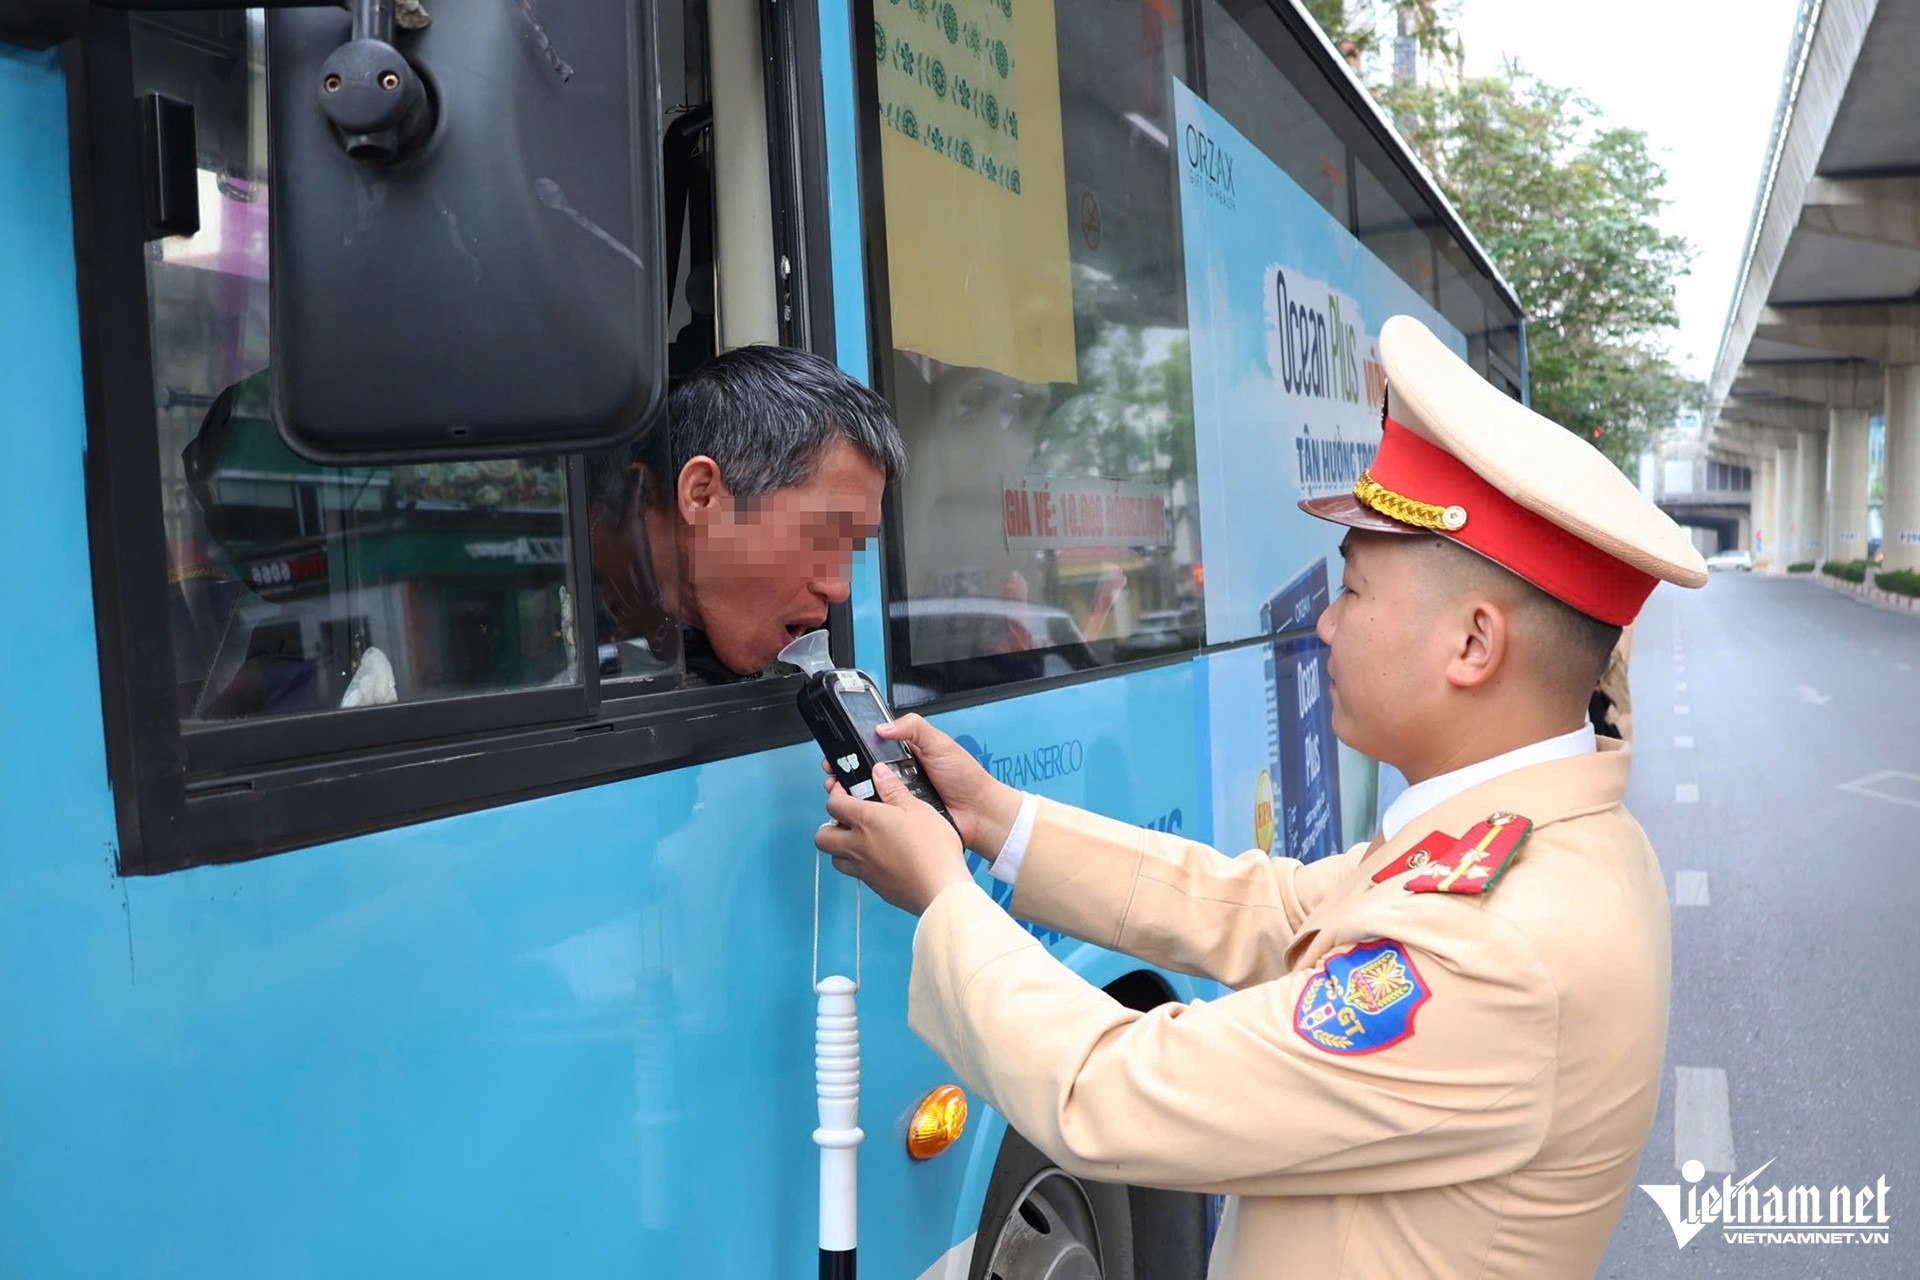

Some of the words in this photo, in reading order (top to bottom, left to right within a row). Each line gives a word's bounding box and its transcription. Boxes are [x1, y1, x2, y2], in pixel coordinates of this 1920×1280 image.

[1186, 123, 1235, 197] ORZAX
[1005, 480, 1032, 537] GIÁ
[1297, 656, 1320, 719] Ocean
[992, 739, 1083, 787] TRANSERCO
[1305, 731, 1320, 787] Plus
